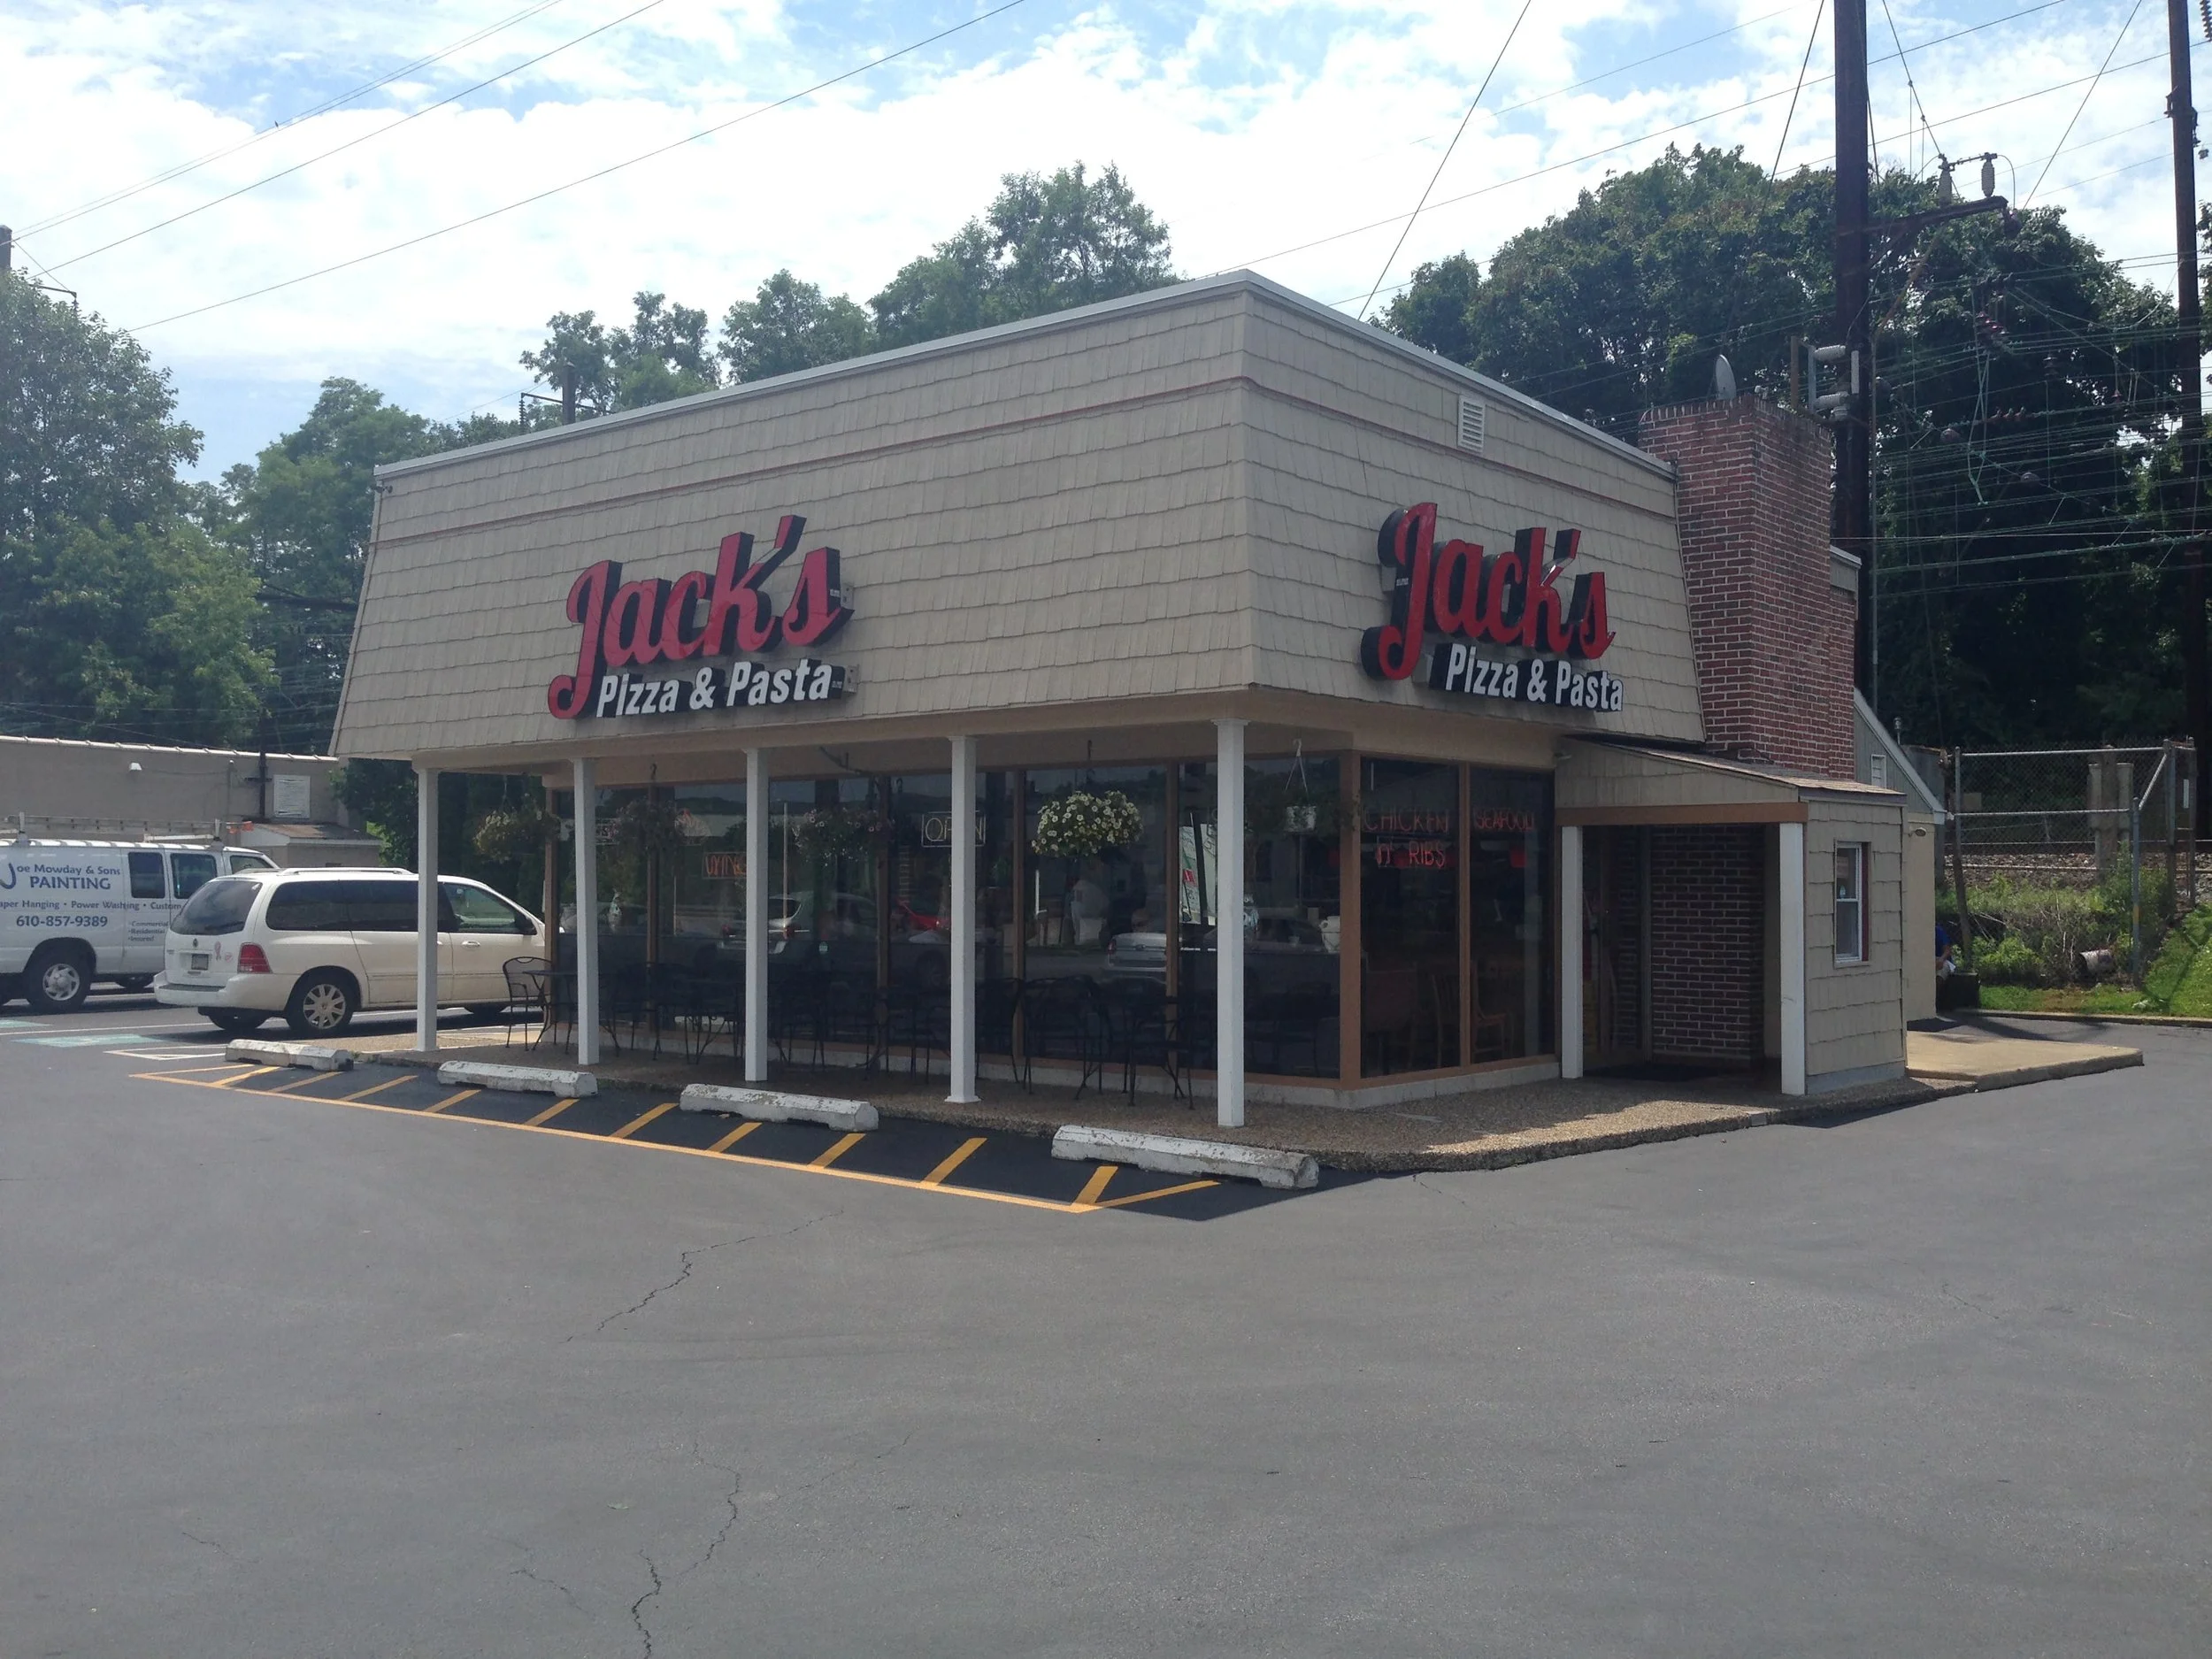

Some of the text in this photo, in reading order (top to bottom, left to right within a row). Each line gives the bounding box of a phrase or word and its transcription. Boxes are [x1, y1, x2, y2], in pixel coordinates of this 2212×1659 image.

[1377, 502, 1617, 681] Jack's
[547, 514, 846, 720] Jack's
[595, 657, 833, 718] Pizza & Pasta
[1445, 642, 1624, 711] Pizza & Pasta
[925, 817, 983, 842] OPN
[1363, 808, 1449, 833] CHICKEN
[1409, 840, 1447, 869] RIBS
[34, 864, 82, 876] Mowday
[85, 865, 95, 875] &
[97, 866, 121, 875] Sons
[29, 876, 111, 890] PAINTING
[21, 899, 60, 910] Hanging
[102, 902, 140, 911] Washing
[16, 915, 109, 927] 610-857-9389
